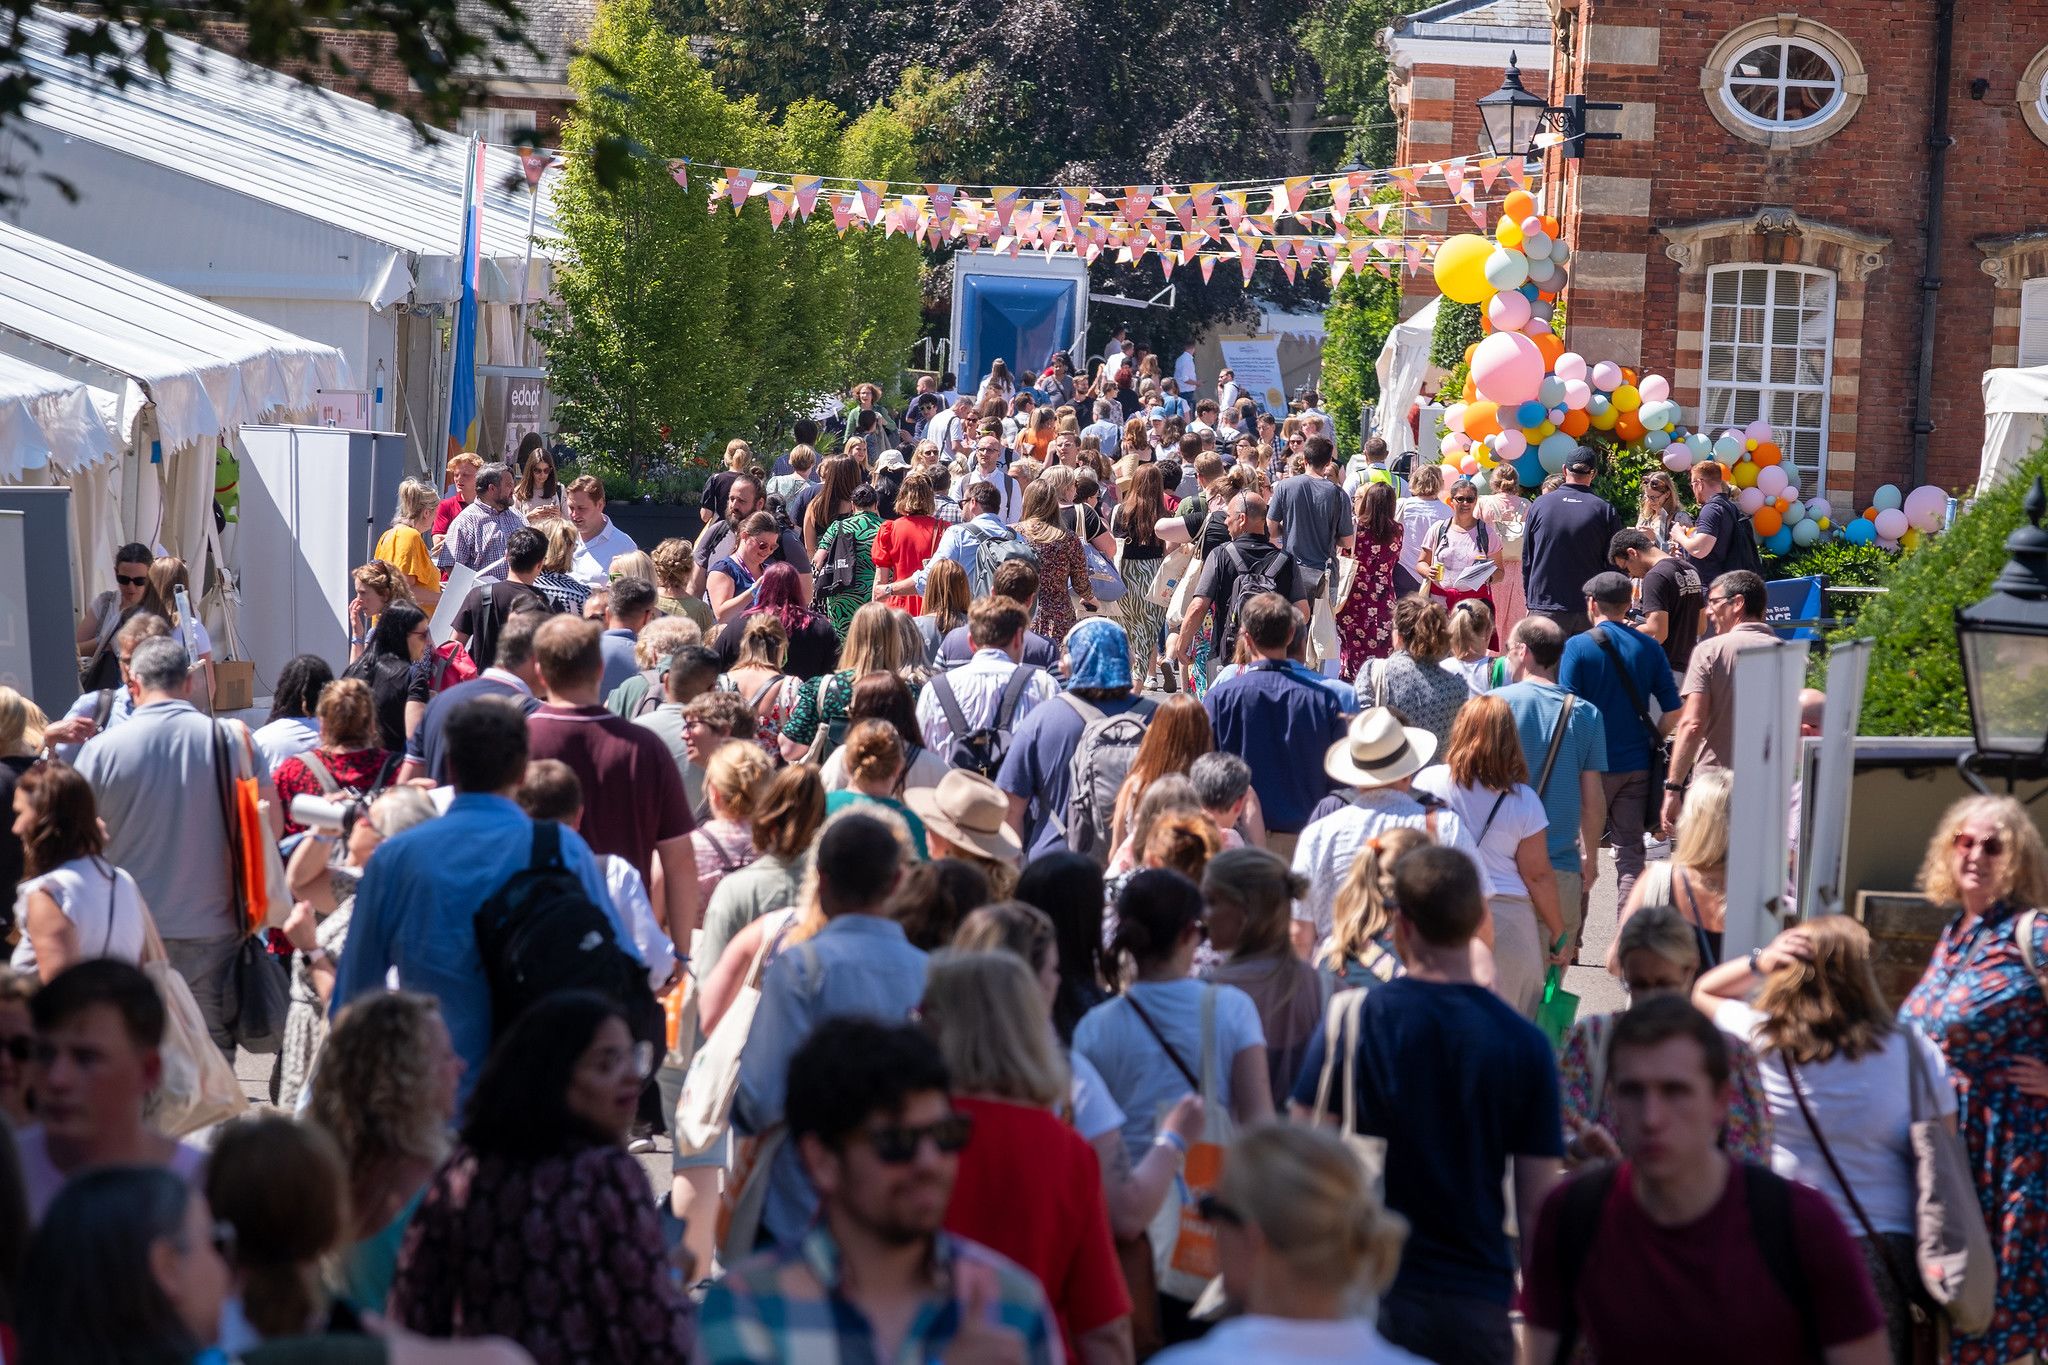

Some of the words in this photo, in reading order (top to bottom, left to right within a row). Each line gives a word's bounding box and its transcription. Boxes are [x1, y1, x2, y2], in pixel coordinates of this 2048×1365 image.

[733, 179, 748, 187] AQA
[935, 194, 949, 202] AQA
[837, 205, 849, 213] AQA
[511, 384, 540, 411] edapt
